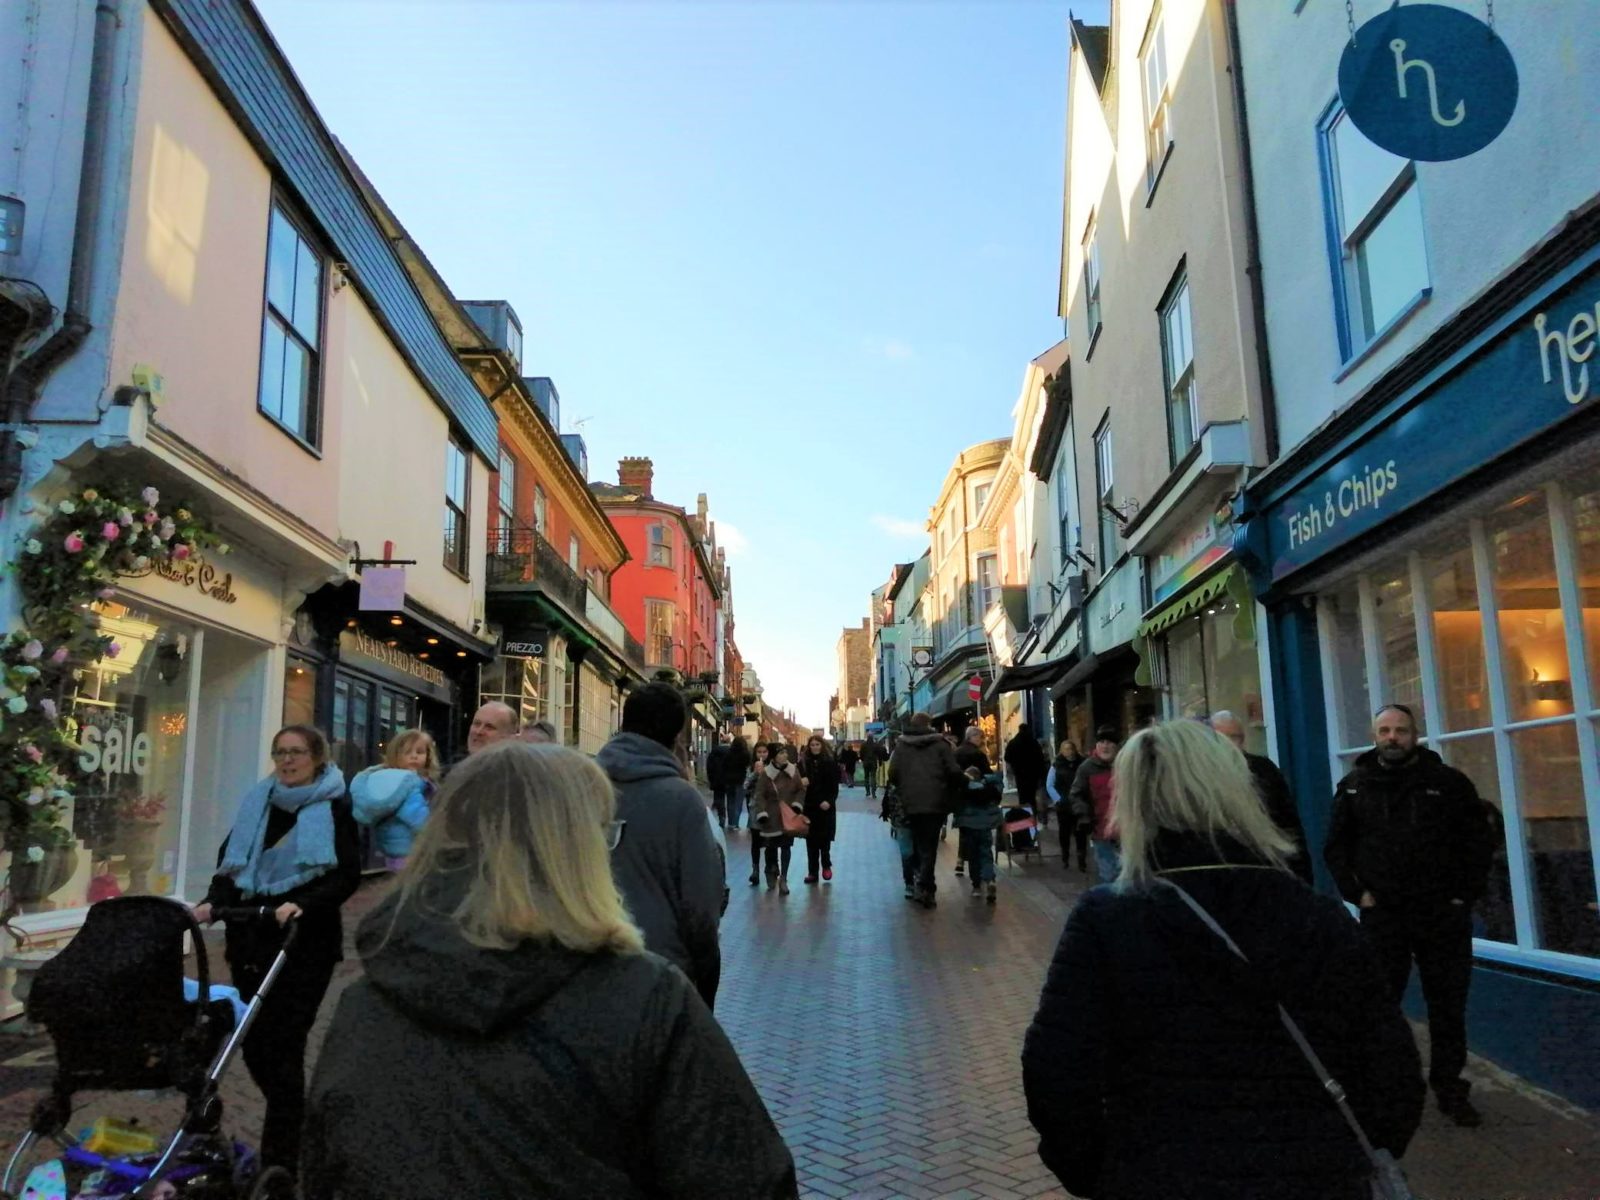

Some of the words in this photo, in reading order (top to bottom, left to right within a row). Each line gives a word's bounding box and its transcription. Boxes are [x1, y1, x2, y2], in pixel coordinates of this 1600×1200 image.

[1288, 503, 1322, 550] Fish
[1325, 491, 1336, 528] &
[1338, 459, 1398, 518] Chips
[387, 645, 409, 673] YARD
[409, 653, 444, 688] REMEDIES
[505, 641, 543, 654] PREZZO
